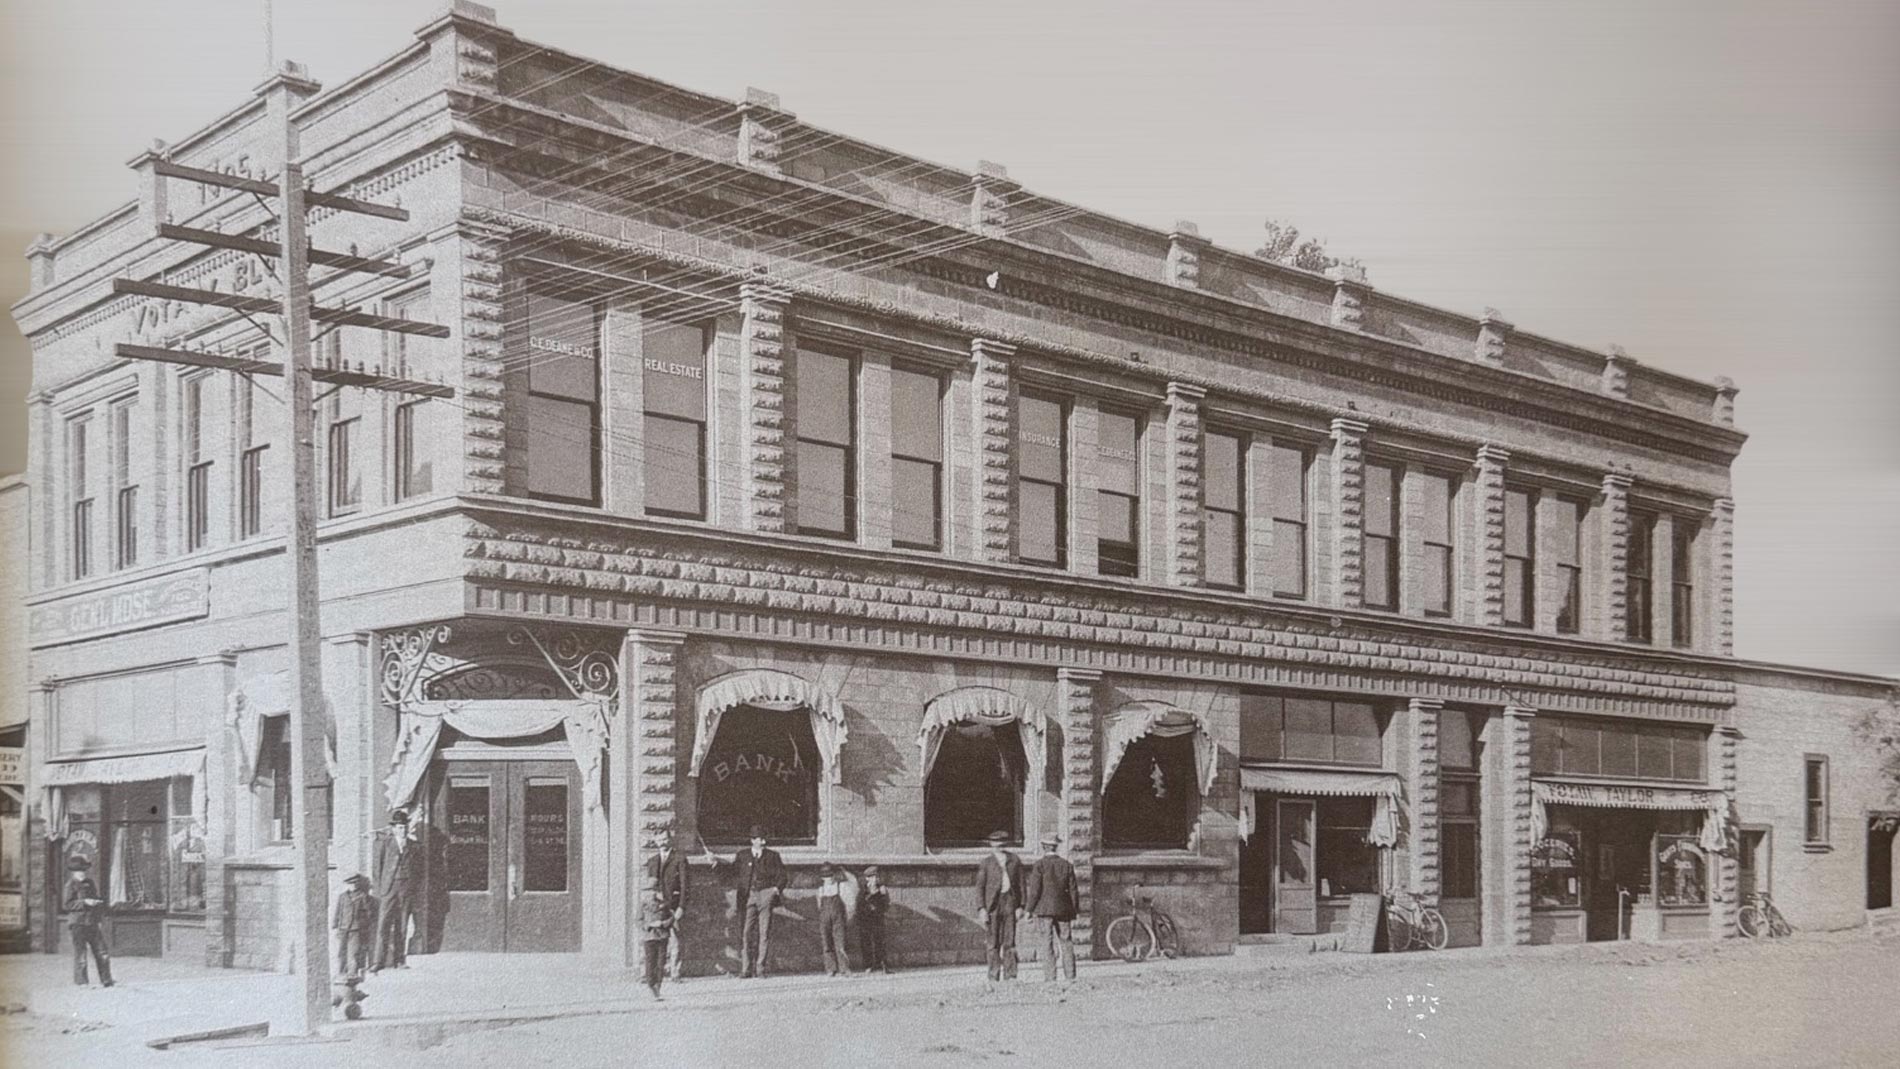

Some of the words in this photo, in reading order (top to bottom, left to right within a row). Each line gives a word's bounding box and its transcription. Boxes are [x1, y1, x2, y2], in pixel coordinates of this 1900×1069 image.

[644, 358, 669, 373] REAL
[670, 363, 703, 379] ESTATE
[714, 753, 796, 783] BANK
[1603, 786, 1655, 803] TAYLOR
[453, 814, 486, 824] BANK
